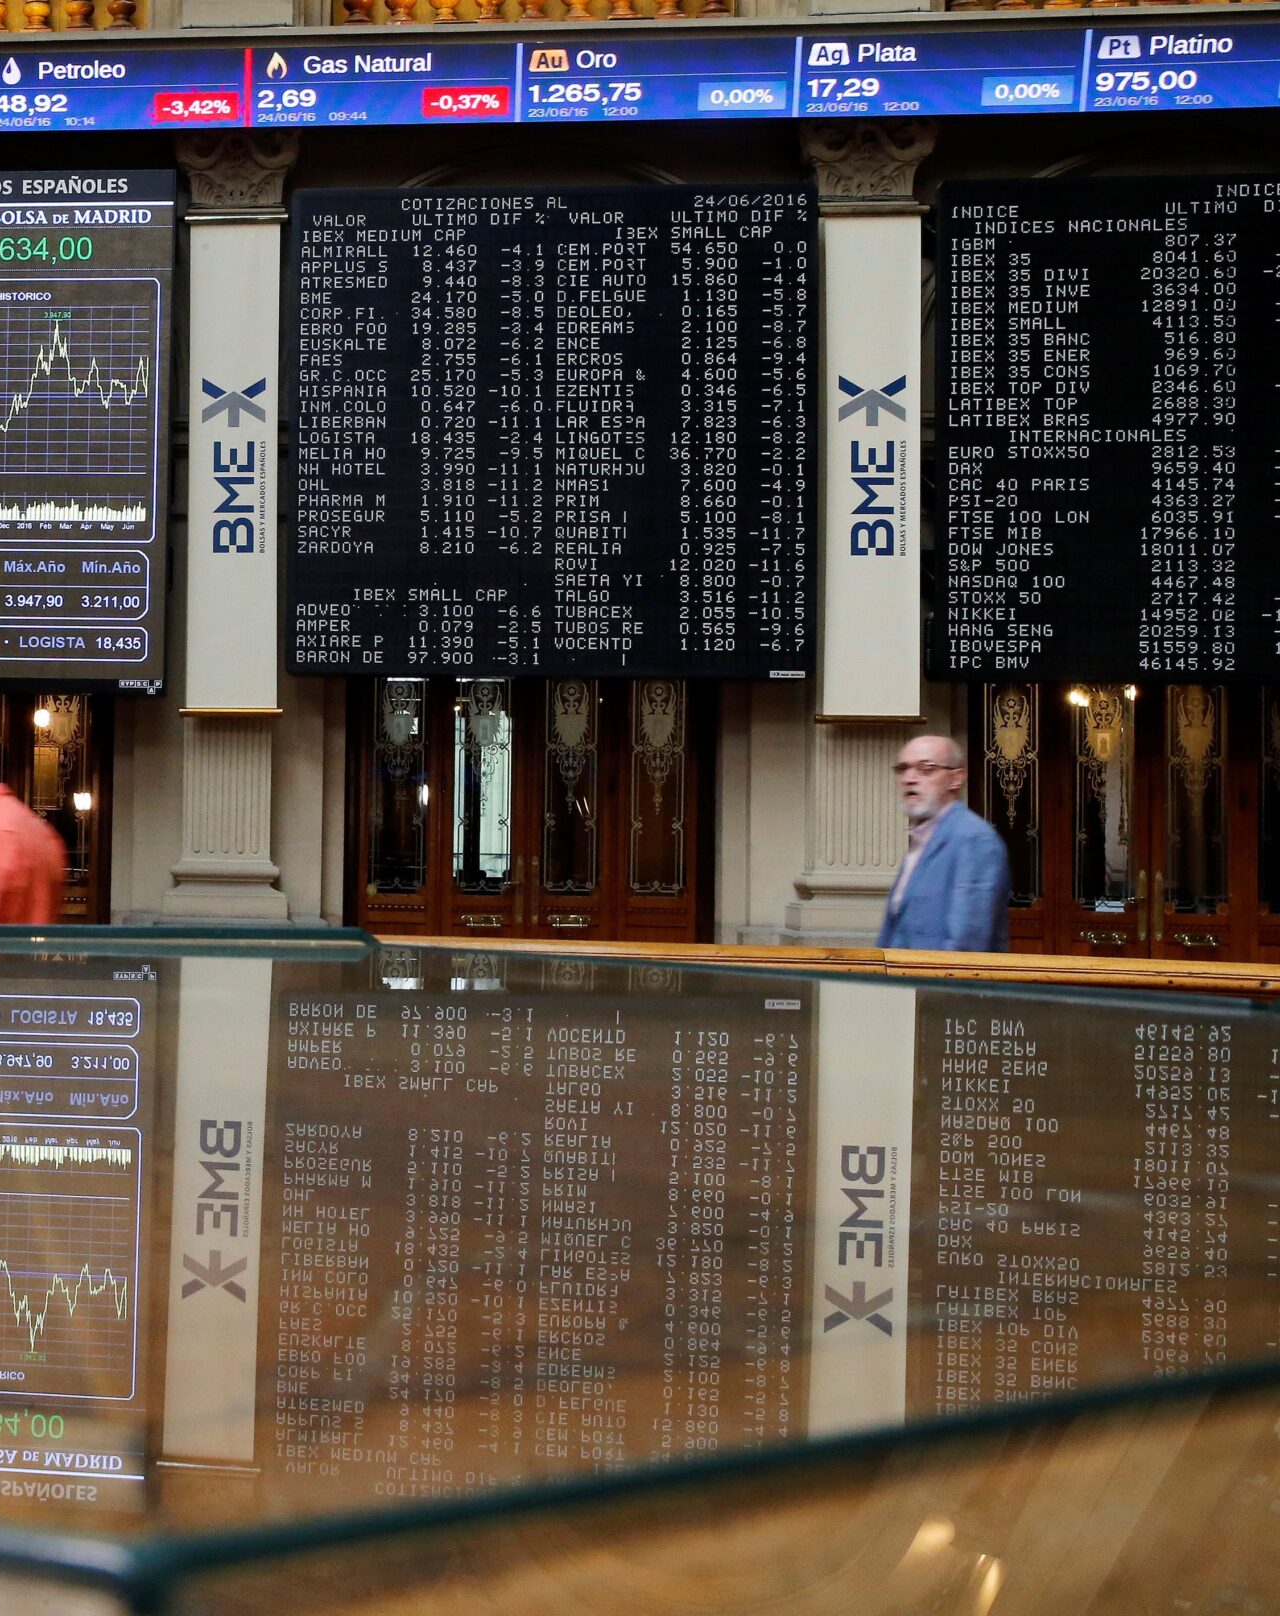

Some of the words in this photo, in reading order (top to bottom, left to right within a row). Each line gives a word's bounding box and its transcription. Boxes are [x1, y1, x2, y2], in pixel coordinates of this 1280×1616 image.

[1150, 34, 1233, 55] Platino
[577, 50, 616, 68] Oro
[858, 43, 916, 62] Plata
[39, 60, 125, 79] Petroleo
[304, 56, 347, 74] Gas
[355, 53, 431, 73] Natural
[806, 78, 880, 101] 17,29
[995, 84, 1059, 101] 0,00%
[1095, 70, 1197, 94] 975,00
[258, 89, 316, 113] 2,69
[431, 95, 499, 112] -0,37%
[529, 83, 641, 105] 1.265,75
[1094, 96, 1158, 106] 23/06/16
[163, 100, 230, 117] -3,42%
[23, 176, 127, 194] ESPAÑOLES
[402, 197, 533, 210] COTIZACIONES
[547, 197, 567, 208] AL
[695, 194, 806, 207] 24/06/2016
[53, 214, 69, 224] DE
[73, 209, 152, 225] MADRID
[303, 231, 343, 242] IBEX
[357, 230, 421, 241] MEDIUM
[435, 229, 465, 241] CAP
[302, 246, 387, 257] ALMIRALL
[300, 385, 386, 397] HISPANIA
[412, 385, 475, 397] 10.520
[1010, 429, 1186, 442] INTERNACIONALES
[949, 447, 993, 458] EURO
[1008, 446, 1089, 458] STOXX50
[1152, 445, 1235, 458] 2812.53
[213, 441, 254, 553] BME
[851, 441, 894, 556] BME
[298, 510, 384, 522] PROSEGUR
[16, 522, 33, 530] 2016
[39, 522, 53, 530] Feb
[59, 522, 73, 531] Mar
[80, 523, 93, 532] Apr
[100, 523, 115, 533] May
[121, 523, 135, 531] Jun
[4, 560, 65, 572] Máx.Año
[82, 561, 140, 573] Mín.Año
[949, 576, 1017, 587] NASDAQ
[1033, 576, 1064, 588] 100
[1152, 576, 1234, 588] 4467.48
[5, 595, 62, 609] 3.947,90
[82, 596, 139, 610] 3.211,00
[555, 606, 632, 618] TUBACEX
[949, 608, 1015, 620] NIKKEI
[20, 636, 85, 648] LOGISTA
[96, 637, 141, 651] 18,435
